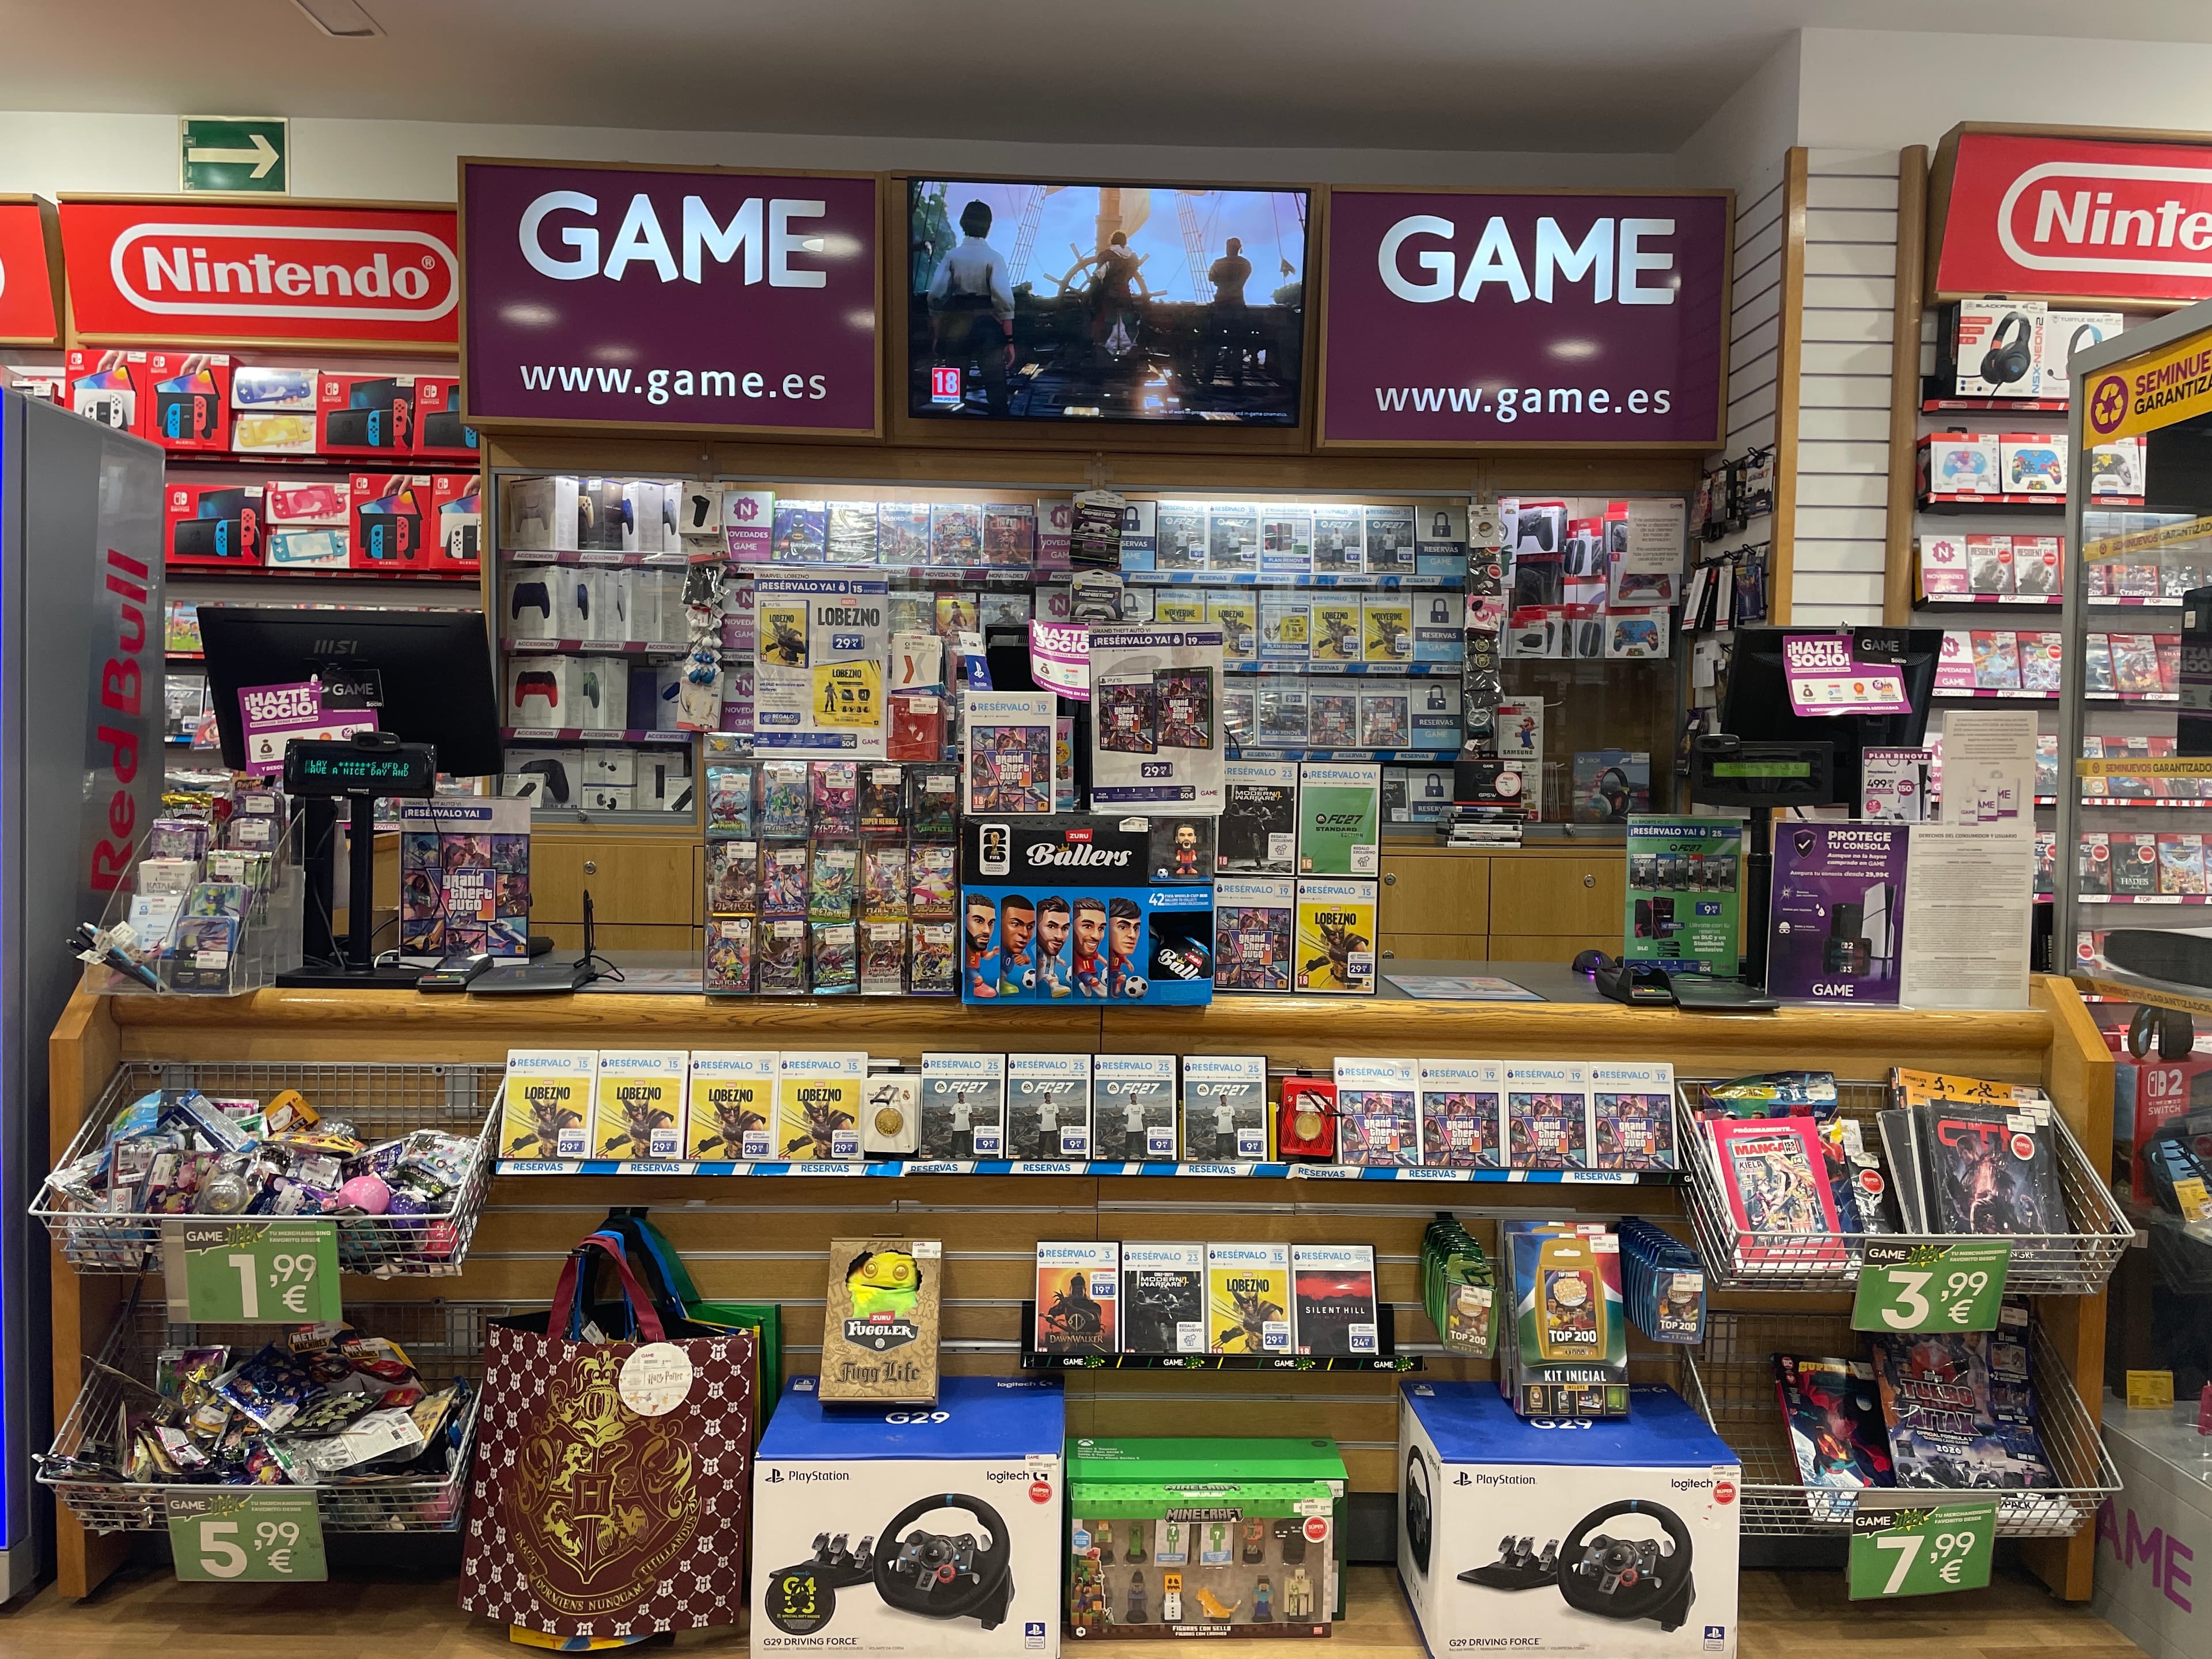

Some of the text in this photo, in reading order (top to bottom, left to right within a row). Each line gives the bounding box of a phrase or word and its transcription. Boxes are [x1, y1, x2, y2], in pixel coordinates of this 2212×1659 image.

[518, 190, 827, 287] GAME
[1378, 215, 1675, 304] GAME
[142, 247, 430, 300] Nintendo
[2135, 350, 2212, 396] SEMINUE
[520, 365, 827, 404] www.game.es
[935, 370, 958, 393] 18
[1376, 387, 1671, 423] www.game.es
[2160, 522, 2212, 540] GARANTIZAD
[733, 543, 757, 551] GAME
[759, 581, 835, 592] ¡RESÉRVALO YA!
[818, 607, 880, 627] LOBEZNO
[1323, 612, 1349, 620] LOBEZNO
[101, 548, 149, 716] Bull
[1094, 634, 1171, 646] ¡RESÉRVALO YA!
[1188, 637, 1198, 645] 19
[1861, 639, 1899, 652] GAME
[1787, 641, 1843, 657] ¡HAZTE
[1791, 653, 1850, 667] SOCIO!
[332, 683, 374, 696] GAME
[245, 687, 310, 711] ¡HAZTE
[251, 700, 319, 721] SOCIO!
[978, 701, 1030, 711] RESÉRVALO
[995, 753, 1025, 767] grand
[1227, 767, 1276, 777] RESÉRVALO
[1282, 770, 1293, 778] 23
[2105, 763, 2152, 772] SEMINUEVOS
[999, 770, 1022, 780] auto
[1308, 770, 1376, 780] ¡RESÉRVALO YA!
[973, 796, 983, 805] 18
[90, 727, 139, 892] Red
[880, 817, 899, 825] HEROES
[1327, 814, 1363, 824] FC27
[1630, 826, 1681, 836] ¡RESÉRVALO
[1828, 831, 1892, 842] PROTEGE
[1843, 842, 1891, 851] CONSOLA
[1027, 842, 1132, 867] Ballers
[2120, 877, 2149, 885] HADES
[1149, 893, 1165, 906] 42
[1315, 912, 1357, 926] LOBEZNO
[1812, 984, 1854, 997] GAME
[518, 1058, 571, 1068] RESÉRVALO
[930, 1059, 982, 1070] RESÉRVALO
[1345, 1067, 1394, 1077] RESÉRVALO
[525, 1085, 570, 1101] LOBEZNO
[948, 1081, 988, 1094] FC27
[2148, 1105, 2181, 1115] SWITCH
[1734, 1143, 1786, 1156] MANGA
[513, 1162, 563, 1172] RESERVAS
[1739, 1160, 1764, 1169] KIELA
[1574, 1172, 1622, 1181] RESERVAS
[187, 1230, 222, 1243] GAME
[1046, 1247, 1096, 1258] RESÉRVALO
[1869, 1248, 1906, 1260] GAME
[1226, 1278, 1270, 1293] LOBEZNO
[1305, 1305, 1365, 1315] SILENT HILL
[848, 1320, 912, 1339] FUGGLER
[1549, 1330, 1597, 1342] TOP 200
[1050, 1334, 1103, 1344] DAWNWALKER
[1063, 1358, 1083, 1366] GAME
[836, 1361, 921, 1384] Fugg Life
[1545, 1369, 1607, 1382] KIT INICIAL
[789, 1469, 851, 1483] PlayStation
[987, 1470, 1030, 1484] logitech
[1166, 1508, 1243, 1521] MINECRAFT
[2095, 1495, 2192, 1613] AME
[535, 1579, 646, 1612] DORMIENS NUNQUAM
[763, 1637, 857, 1646] G29 DRIVING FORCE
